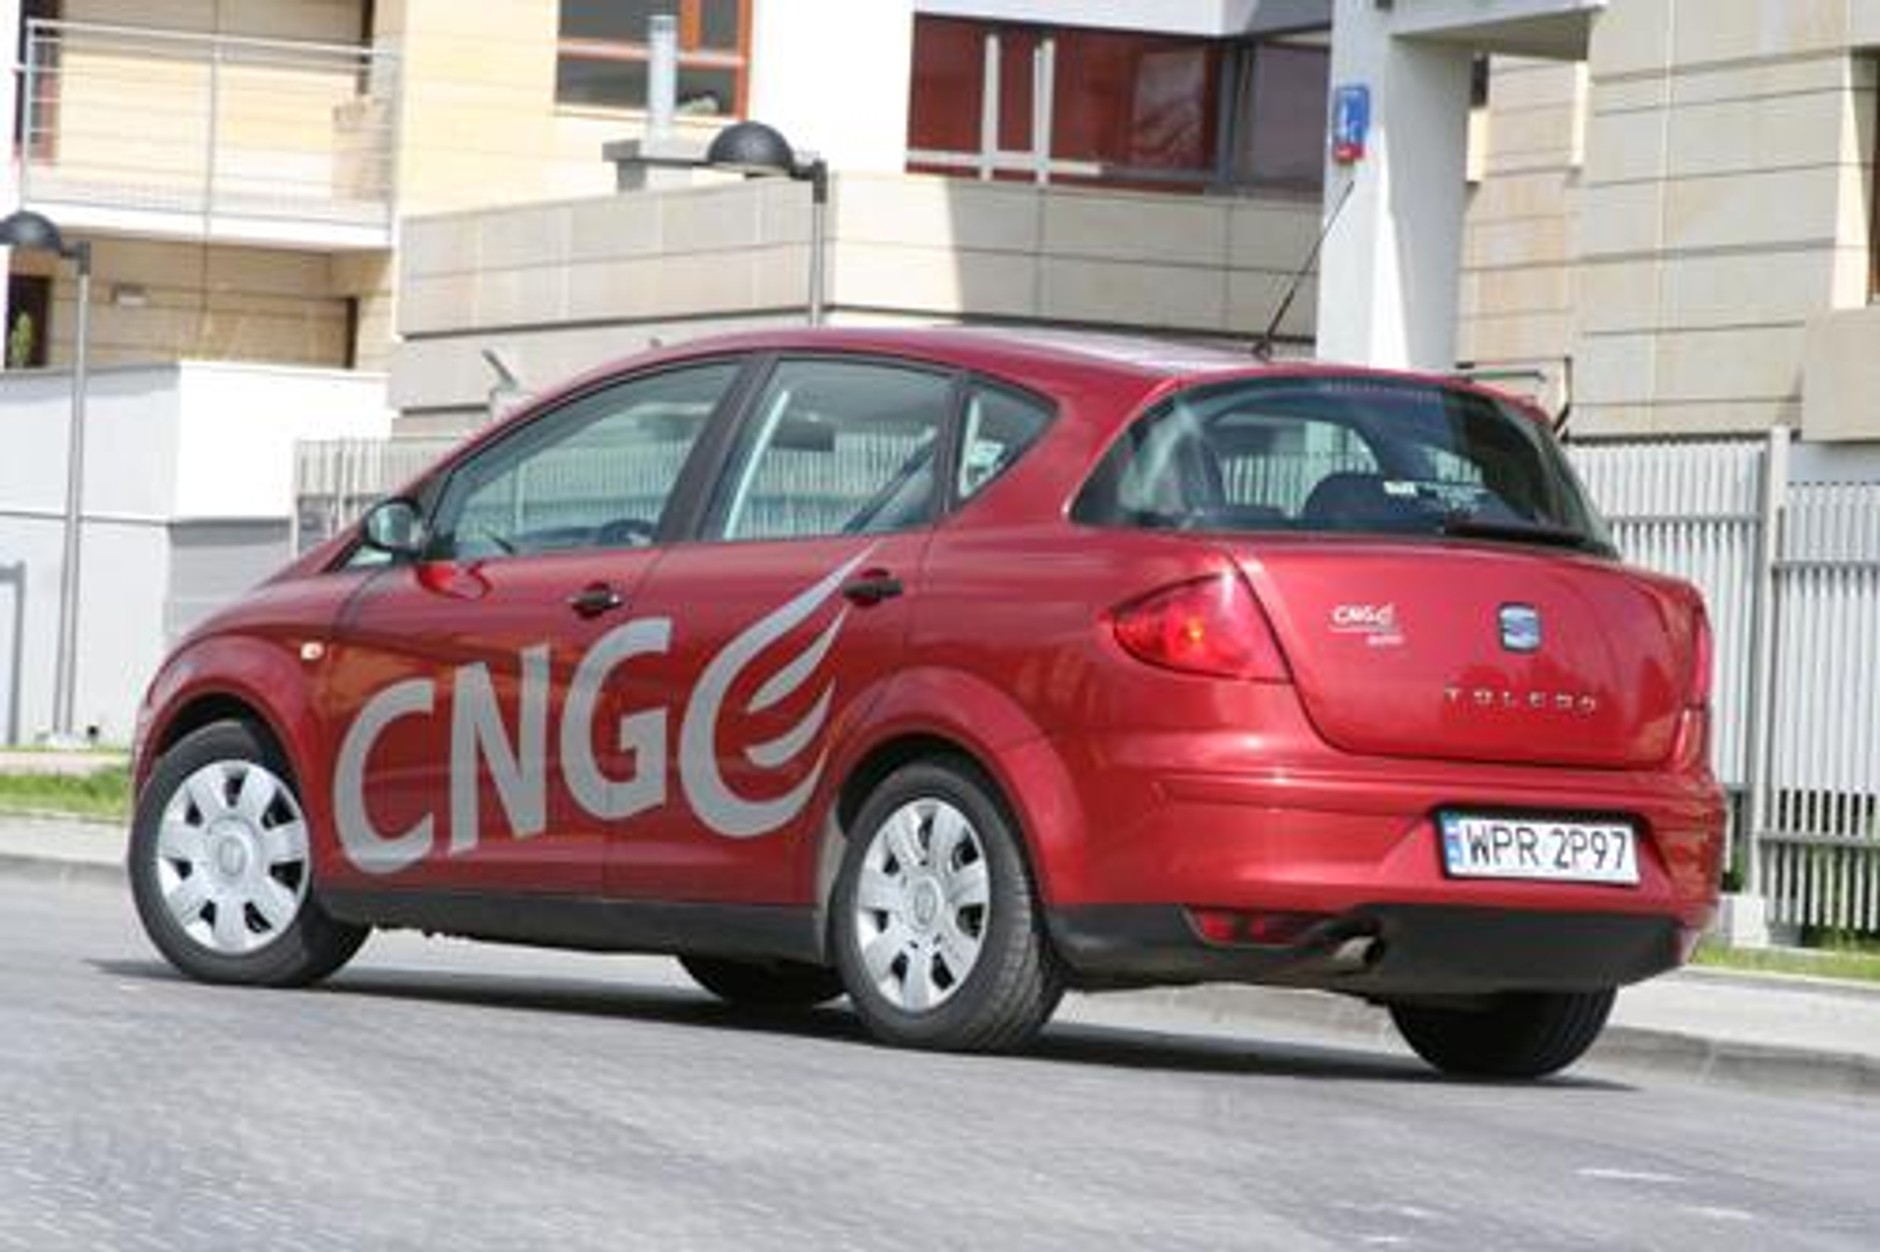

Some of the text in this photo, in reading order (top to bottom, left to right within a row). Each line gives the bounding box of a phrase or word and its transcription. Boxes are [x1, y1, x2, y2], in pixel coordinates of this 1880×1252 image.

[1444, 687, 1596, 710] TOLEDO
[1467, 825, 1626, 870] WPR 2P97
